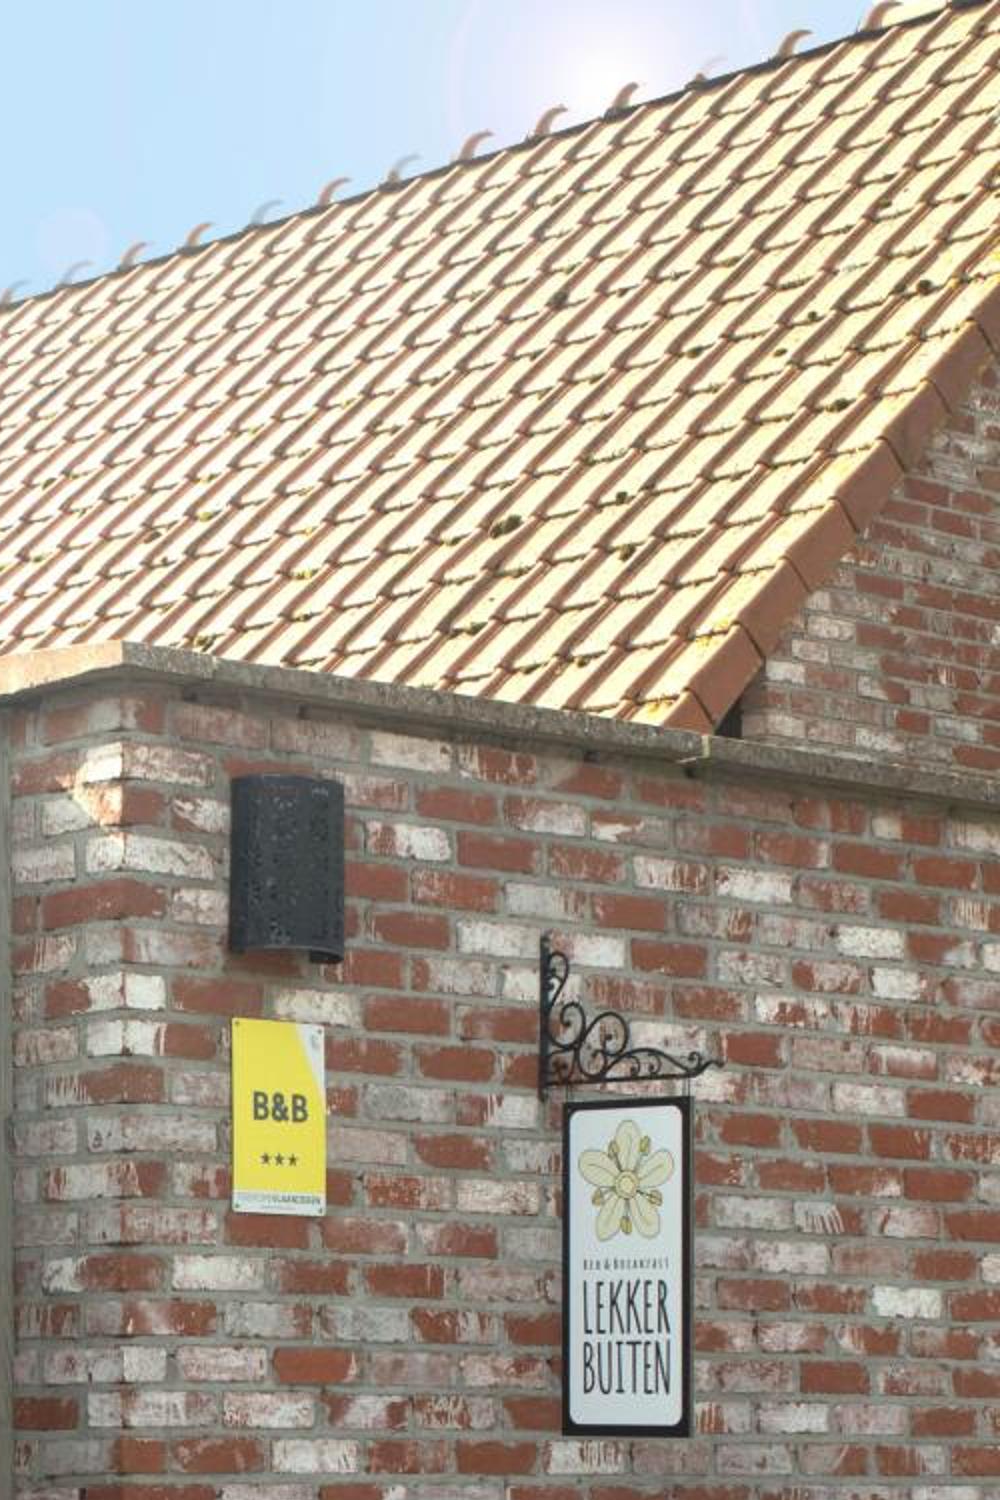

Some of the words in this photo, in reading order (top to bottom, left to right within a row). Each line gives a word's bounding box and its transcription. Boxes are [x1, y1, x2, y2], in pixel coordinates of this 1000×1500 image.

[253, 1091, 308, 1122] B&B
[583, 1280, 671, 1334] LEKKER
[583, 1340, 671, 1394] BUITEN
